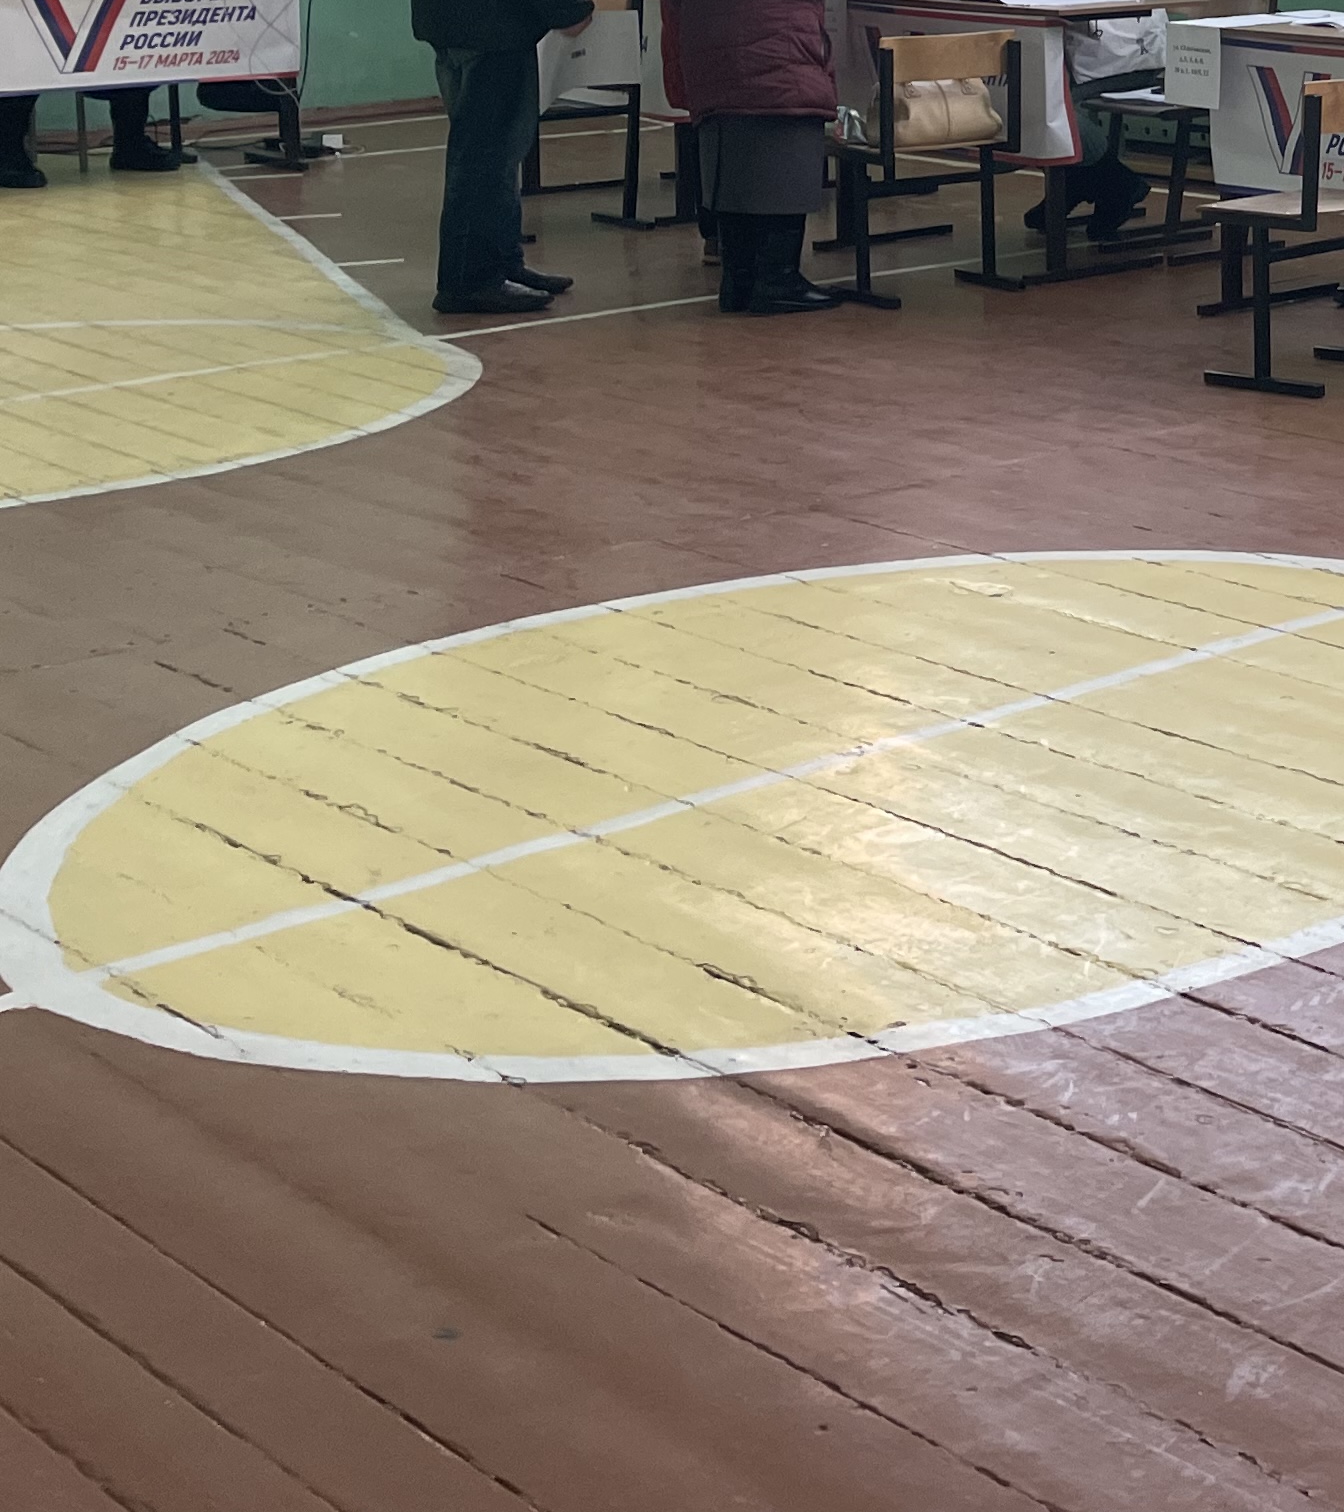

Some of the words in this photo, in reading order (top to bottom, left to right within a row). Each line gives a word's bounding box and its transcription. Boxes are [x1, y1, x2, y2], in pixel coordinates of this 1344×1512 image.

[129, 5, 257, 27] ПРЕЗИДЕНТА
[120, 31, 203, 50] РОССИИ
[155, 52, 203, 68] МАРТА
[206, 49, 241, 65] 2024
